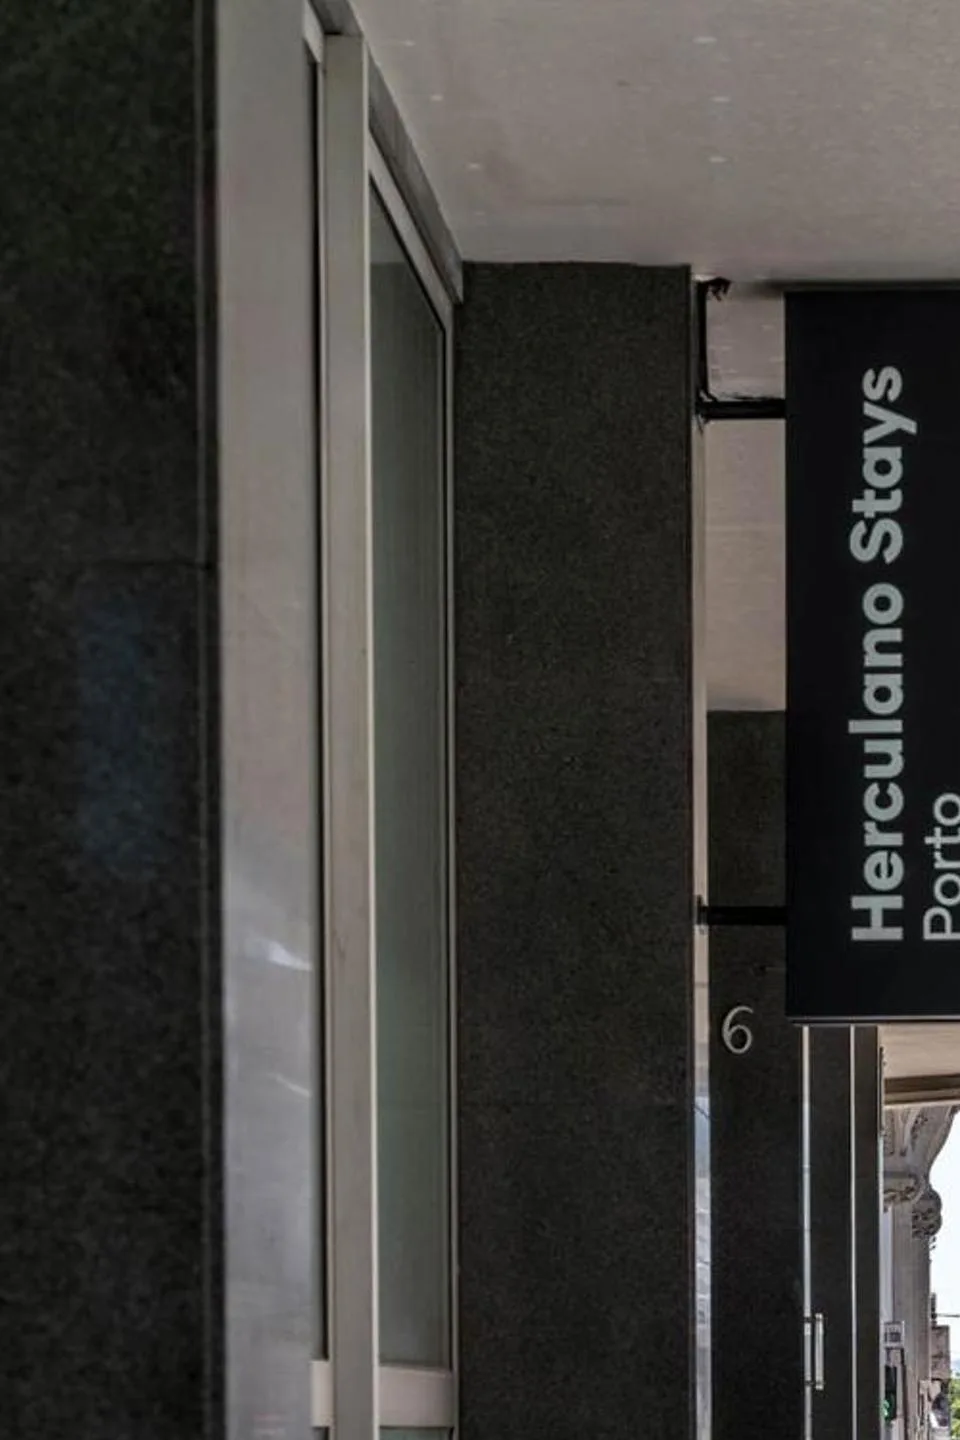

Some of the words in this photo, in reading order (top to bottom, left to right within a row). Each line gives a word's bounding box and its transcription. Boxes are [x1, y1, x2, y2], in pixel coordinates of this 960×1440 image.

[849, 366, 918, 564] Stays
[848, 583, 905, 941] Herculano
[722, 1005, 754, 1055] 6
